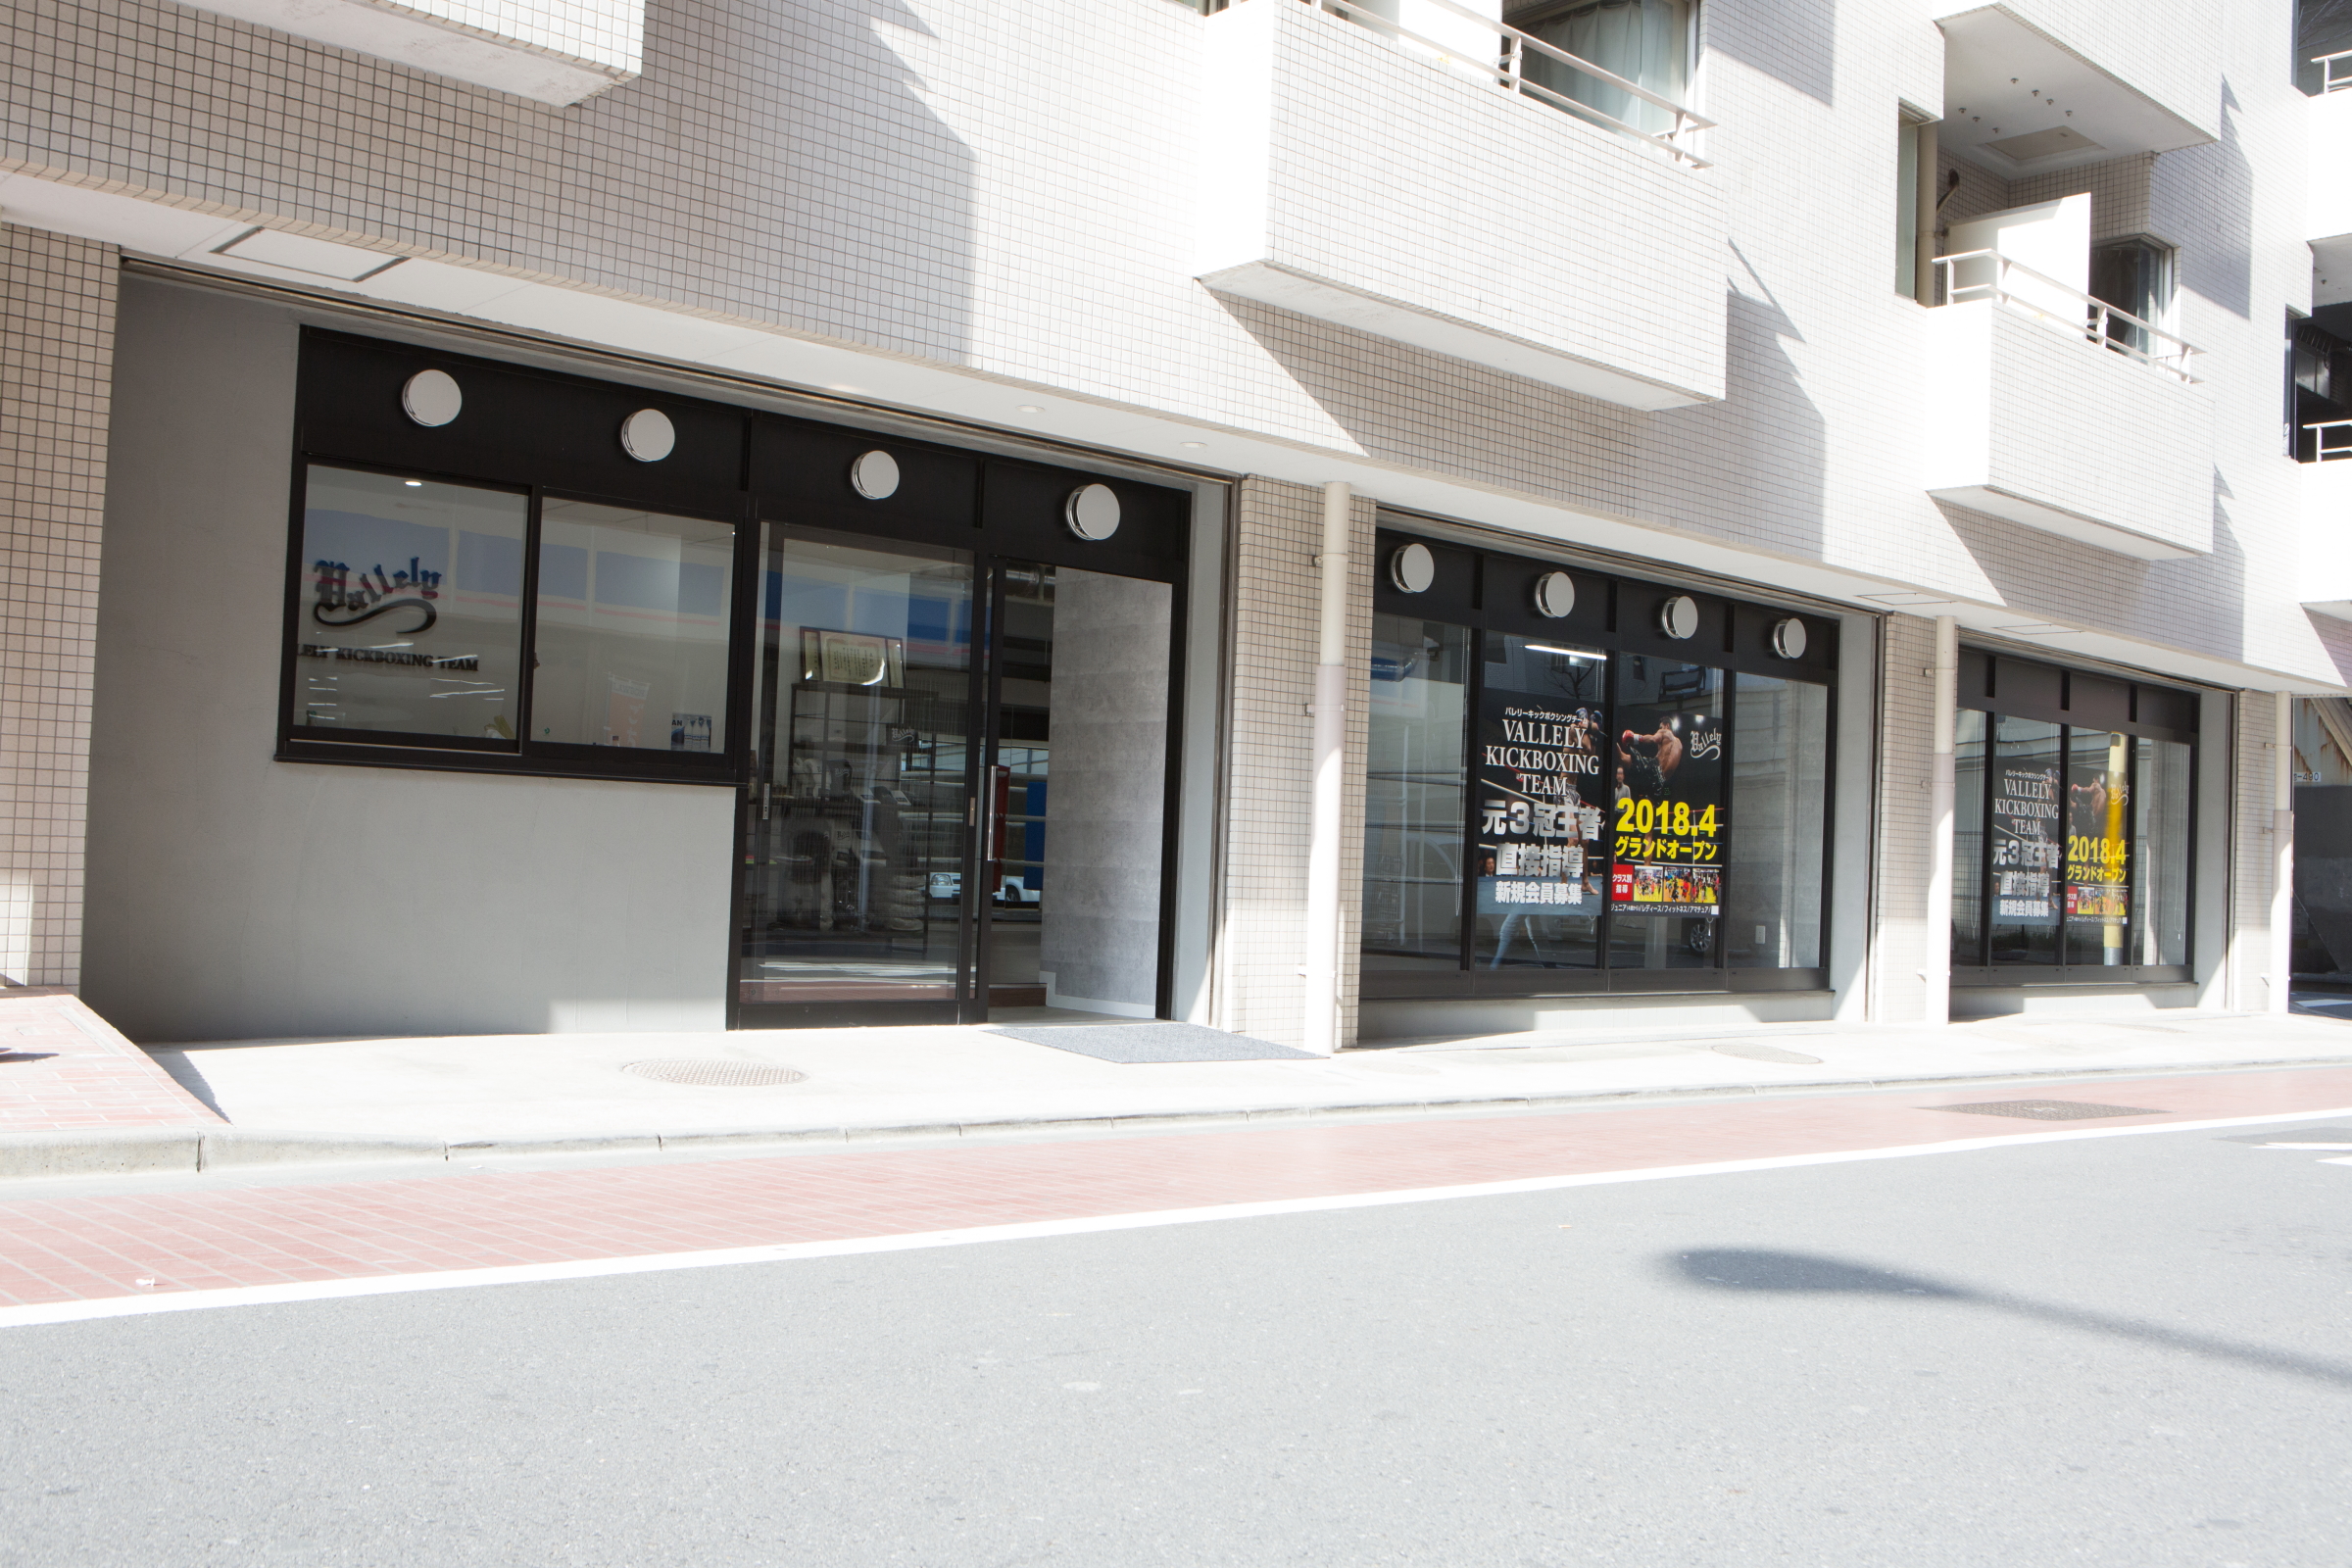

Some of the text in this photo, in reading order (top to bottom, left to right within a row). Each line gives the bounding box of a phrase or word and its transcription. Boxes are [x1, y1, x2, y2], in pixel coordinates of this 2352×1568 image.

[313, 557, 442, 621] Vallely
[336, 648, 433, 667] KICKBOXING
[437, 656, 479, 671] TEAM
[1502, 718, 1588, 749] VALLELY
[1690, 727, 1722, 756] Vallely
[1486, 745, 1599, 775] KICKBOXING
[1519, 773, 1568, 796] TEAM
[2004, 778, 2052, 800] VALLELY
[1482, 800, 1602, 841] 元3冠王者
[1615, 798, 1717, 837] 2018.4
[1994, 799, 2059, 819] KICKBOXING
[2013, 818, 2041, 835] TEAM
[1495, 842, 1584, 878] 直接指導
[1615, 836, 1718, 861] グランドオープン
[1992, 839, 2060, 869] 元3冠王者
[2068, 835, 2126, 864] 2018.4
[1612, 874, 1633, 884] クラス別
[1999, 871, 2050, 898] 直接指導
[2067, 866, 2127, 883] グランドオープン
[1495, 880, 1583, 906] 新規会員募集
[1999, 900, 2050, 917] 新規会員募集
